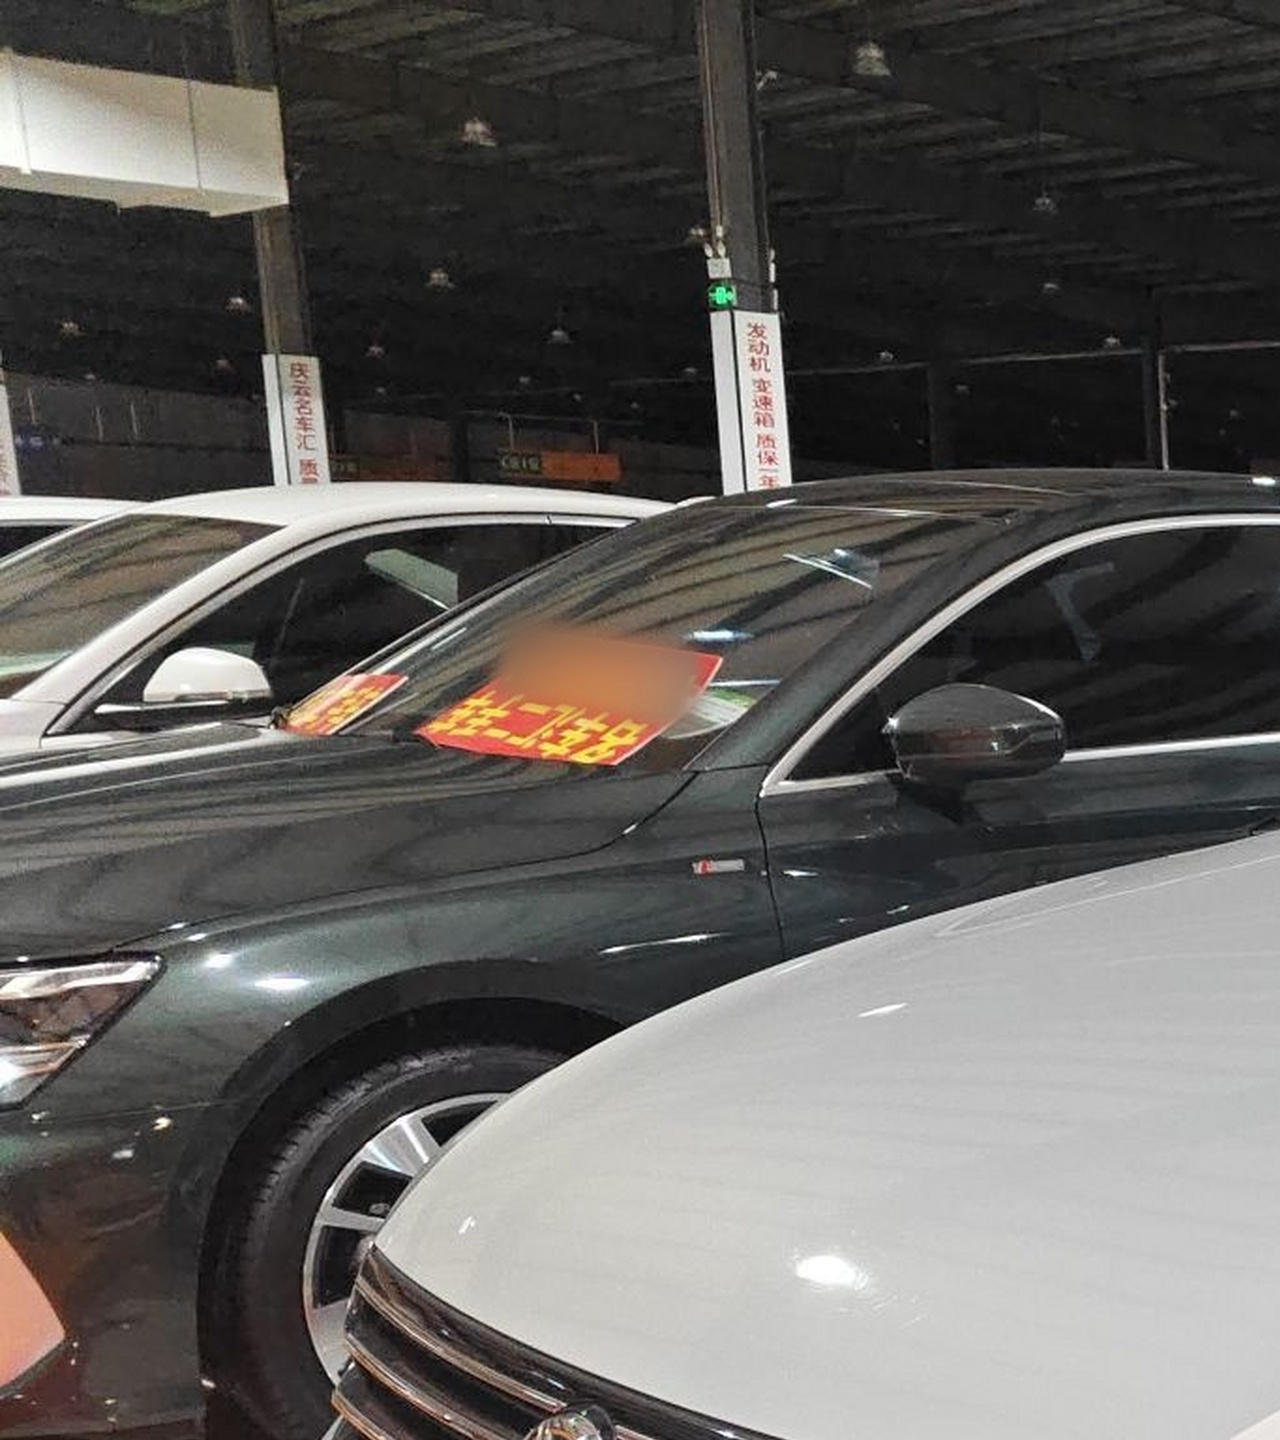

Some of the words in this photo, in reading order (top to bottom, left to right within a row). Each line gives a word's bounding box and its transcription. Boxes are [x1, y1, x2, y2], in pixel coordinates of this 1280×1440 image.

[747, 321, 771, 373] 发动机
[290, 361, 316, 451] 庆云名车汇
[752, 378, 775, 429] 变速箱
